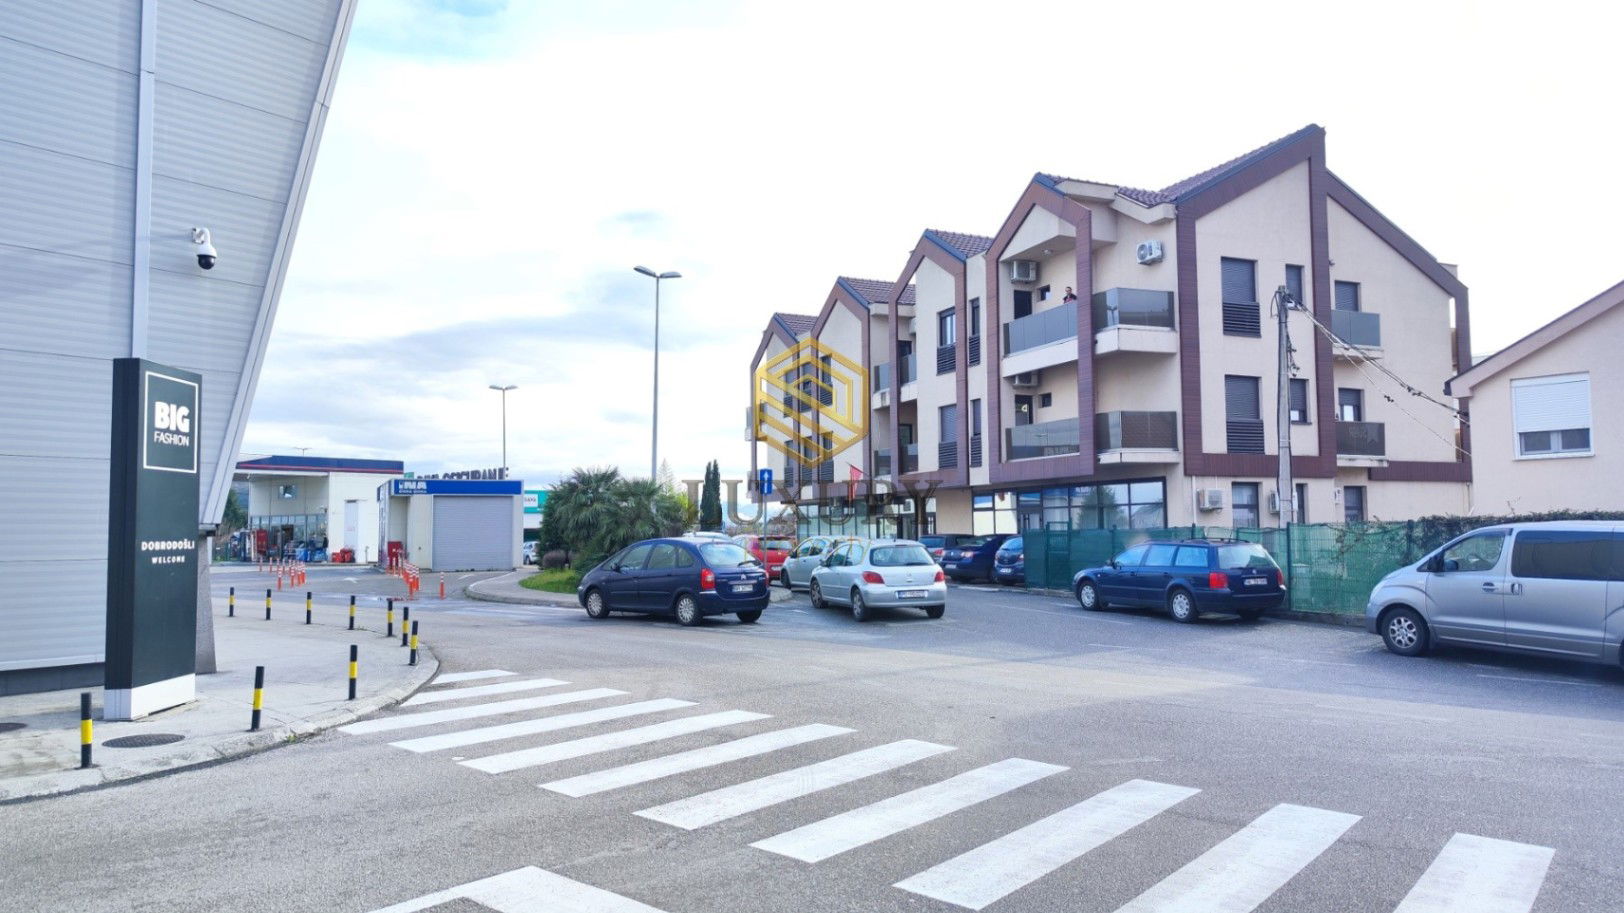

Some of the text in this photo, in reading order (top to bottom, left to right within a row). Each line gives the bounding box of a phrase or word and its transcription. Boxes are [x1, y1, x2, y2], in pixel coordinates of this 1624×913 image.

[154, 401, 190, 433] BIG
[154, 431, 190, 446] FASHION
[141, 538, 195, 551] DOBRODOŠLI
[151, 556, 186, 564] WELCOME
